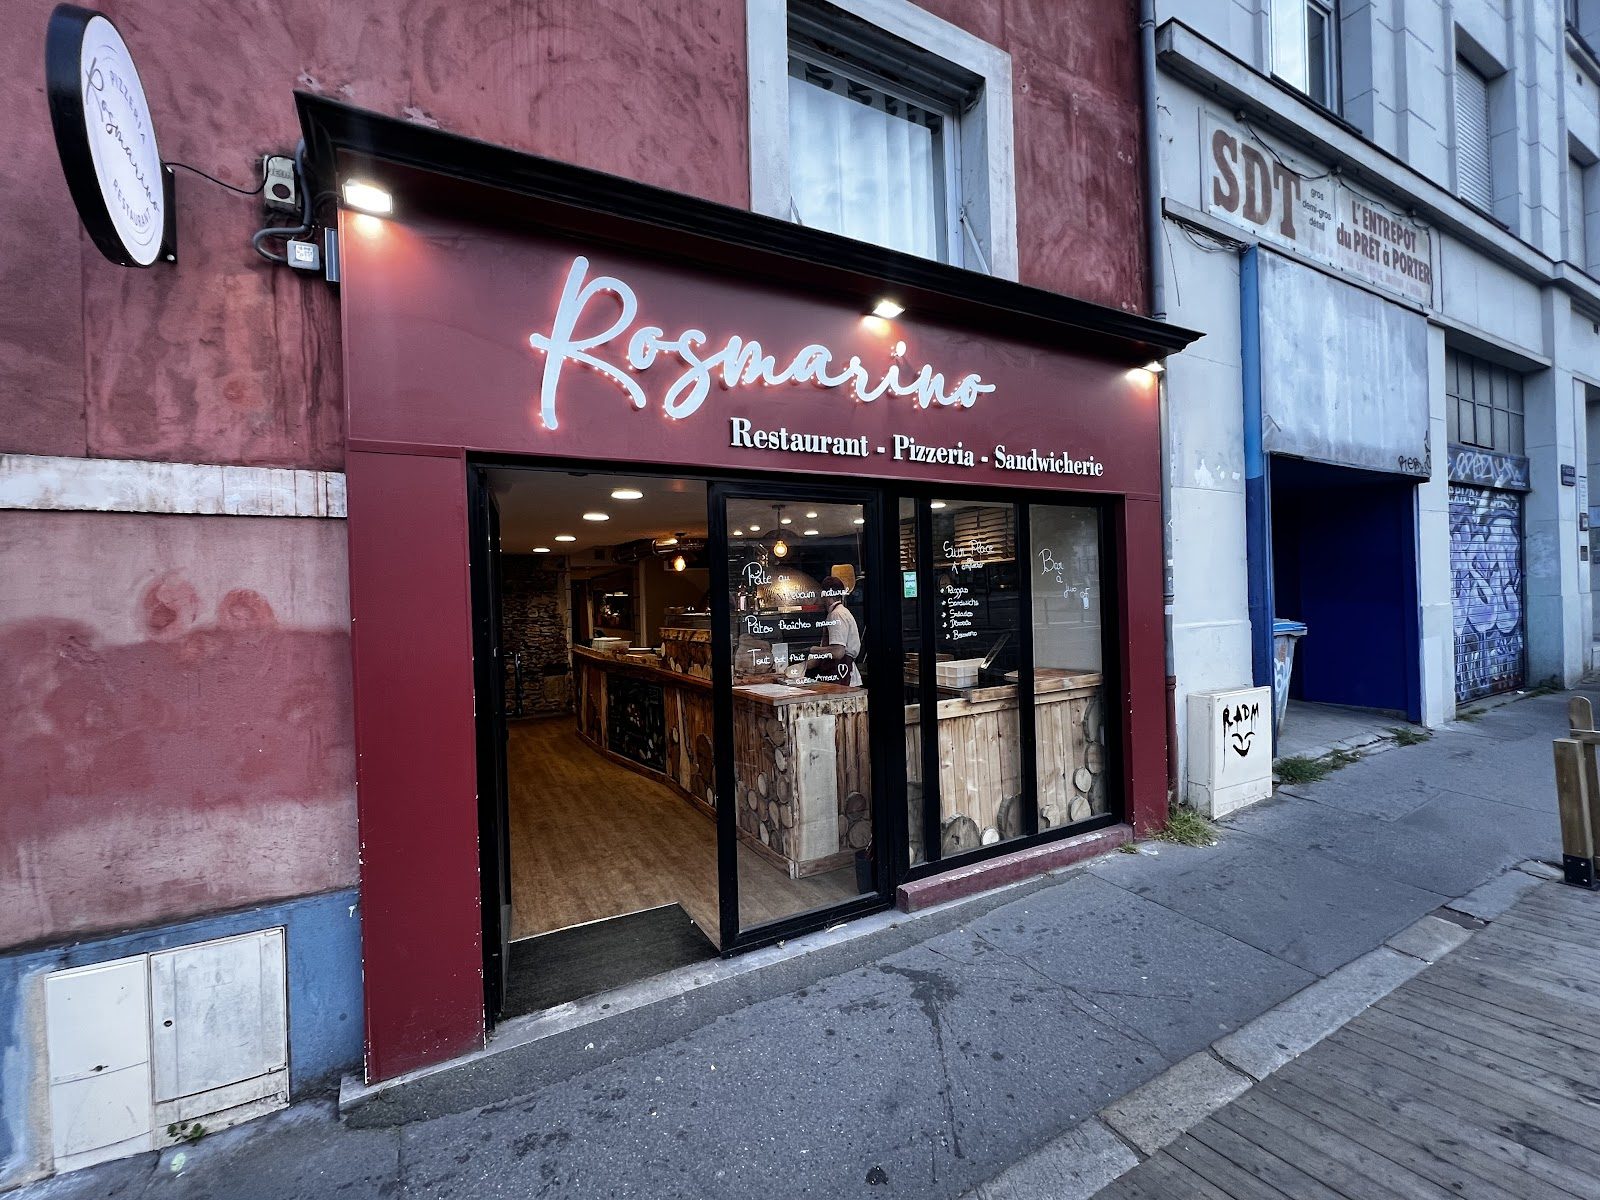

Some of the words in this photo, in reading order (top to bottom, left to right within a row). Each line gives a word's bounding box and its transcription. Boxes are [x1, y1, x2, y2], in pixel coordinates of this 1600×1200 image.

[1212, 129, 1301, 240] SDT
[1311, 188, 1324, 200] gros
[112, 178, 153, 228] RESTAURANT
[1302, 200, 1331, 220] demi-gros
[1336, 222, 1352, 250] du
[1382, 244, 1390, 267] à
[1392, 247, 1431, 285] PORTER
[529, 255, 996, 431] Rosmarino
[730, 416, 869, 457] Restaurant
[892, 434, 974, 467] Pizzeria
[994, 444, 1103, 476] Sandwicherie
[970, 539, 995, 554] Place
[742, 561, 772, 586] Pâte
[1038, 548, 1064, 575] Bar
[747, 648, 771, 666] Tout
